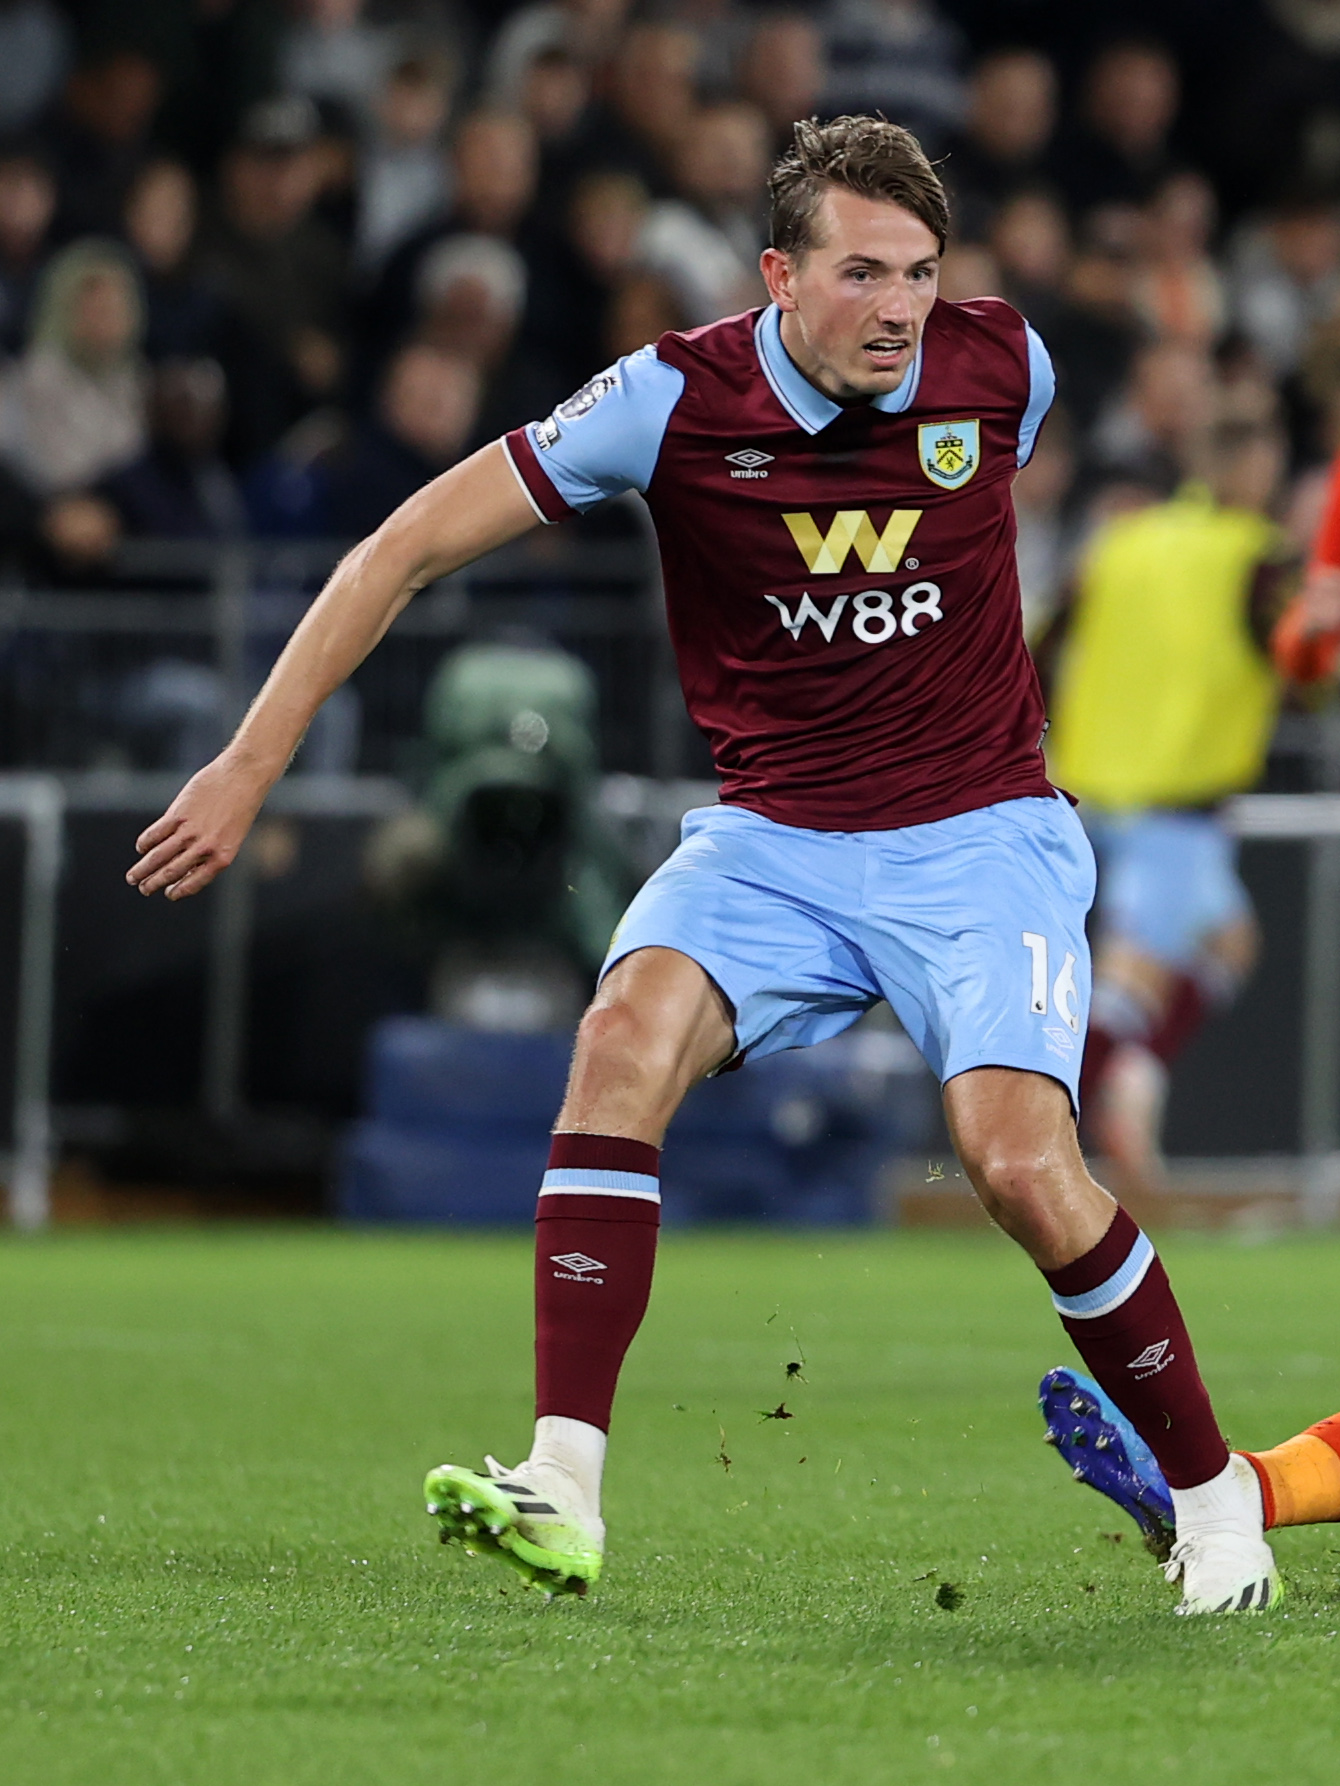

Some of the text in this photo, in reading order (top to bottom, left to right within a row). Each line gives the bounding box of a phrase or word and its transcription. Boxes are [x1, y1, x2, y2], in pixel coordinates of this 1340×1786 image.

[730, 469, 768, 479] umbro
[763, 581, 944, 644] W88
[1022, 930, 1080, 1036] 16
[553, 1271, 604, 1285] umbro
